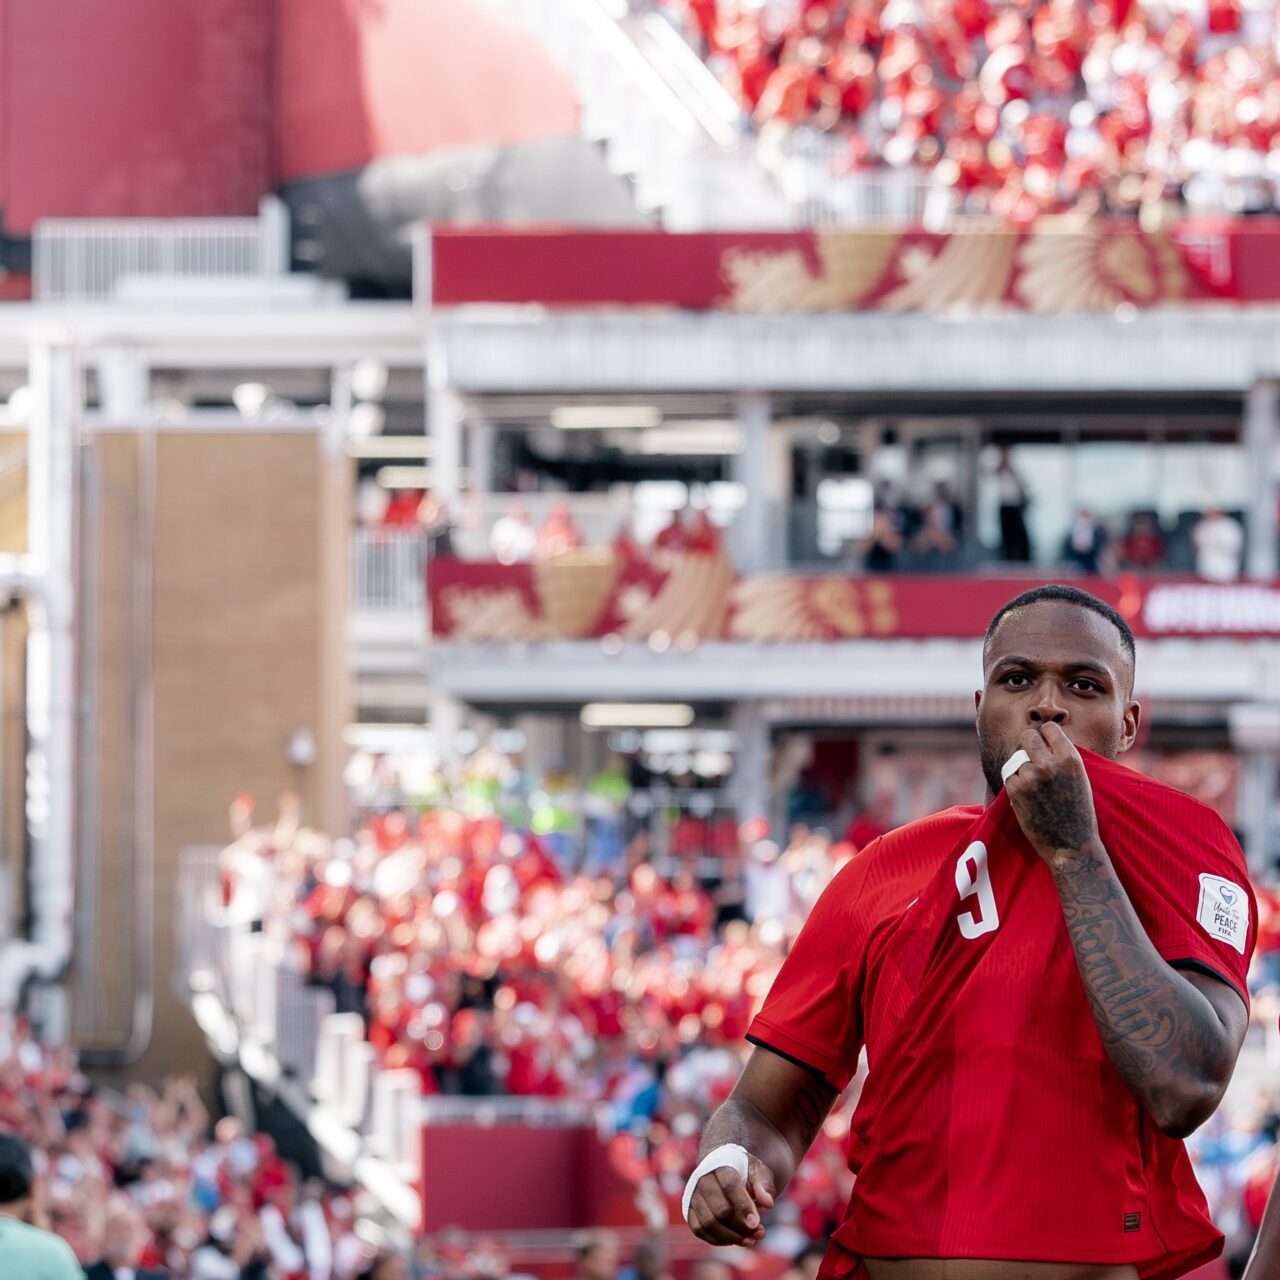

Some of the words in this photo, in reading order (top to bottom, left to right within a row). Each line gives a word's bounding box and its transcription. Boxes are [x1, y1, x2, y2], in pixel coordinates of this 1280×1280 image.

[955, 840, 999, 940] 9
[1214, 913, 1238, 933] PEACE
[1218, 927, 1232, 937] FIFA
